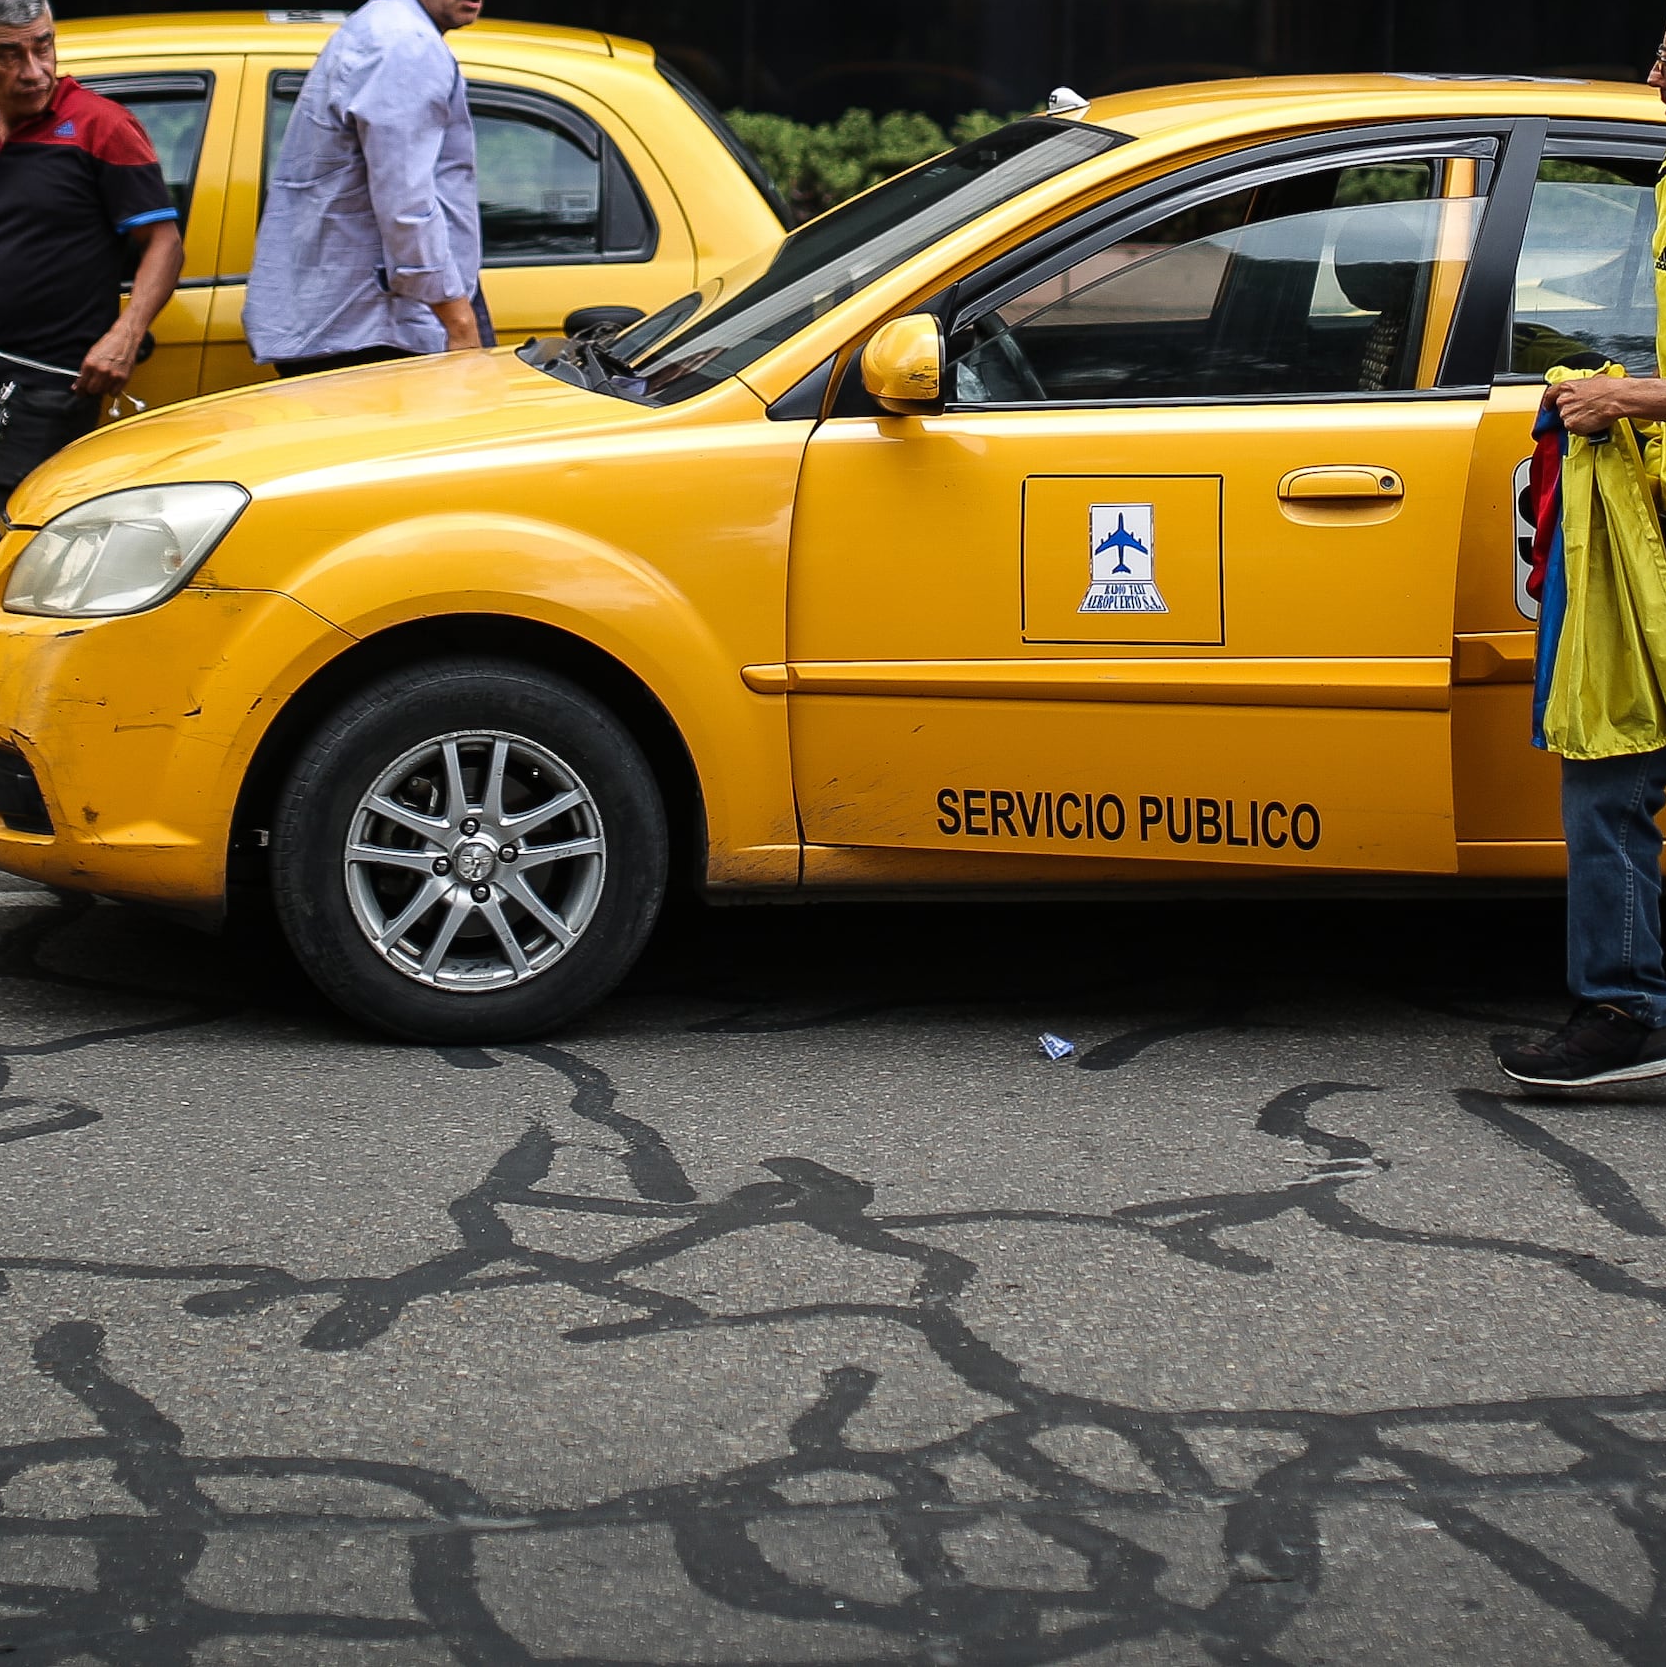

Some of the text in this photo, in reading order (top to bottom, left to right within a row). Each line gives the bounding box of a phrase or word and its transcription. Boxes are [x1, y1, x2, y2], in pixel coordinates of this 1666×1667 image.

[1104, 584, 1147, 595] RADIO TAXI
[1085, 594, 1142, 610] AEROPUERTO
[935, 787, 1323, 852] SERVICIO PUBLICO
